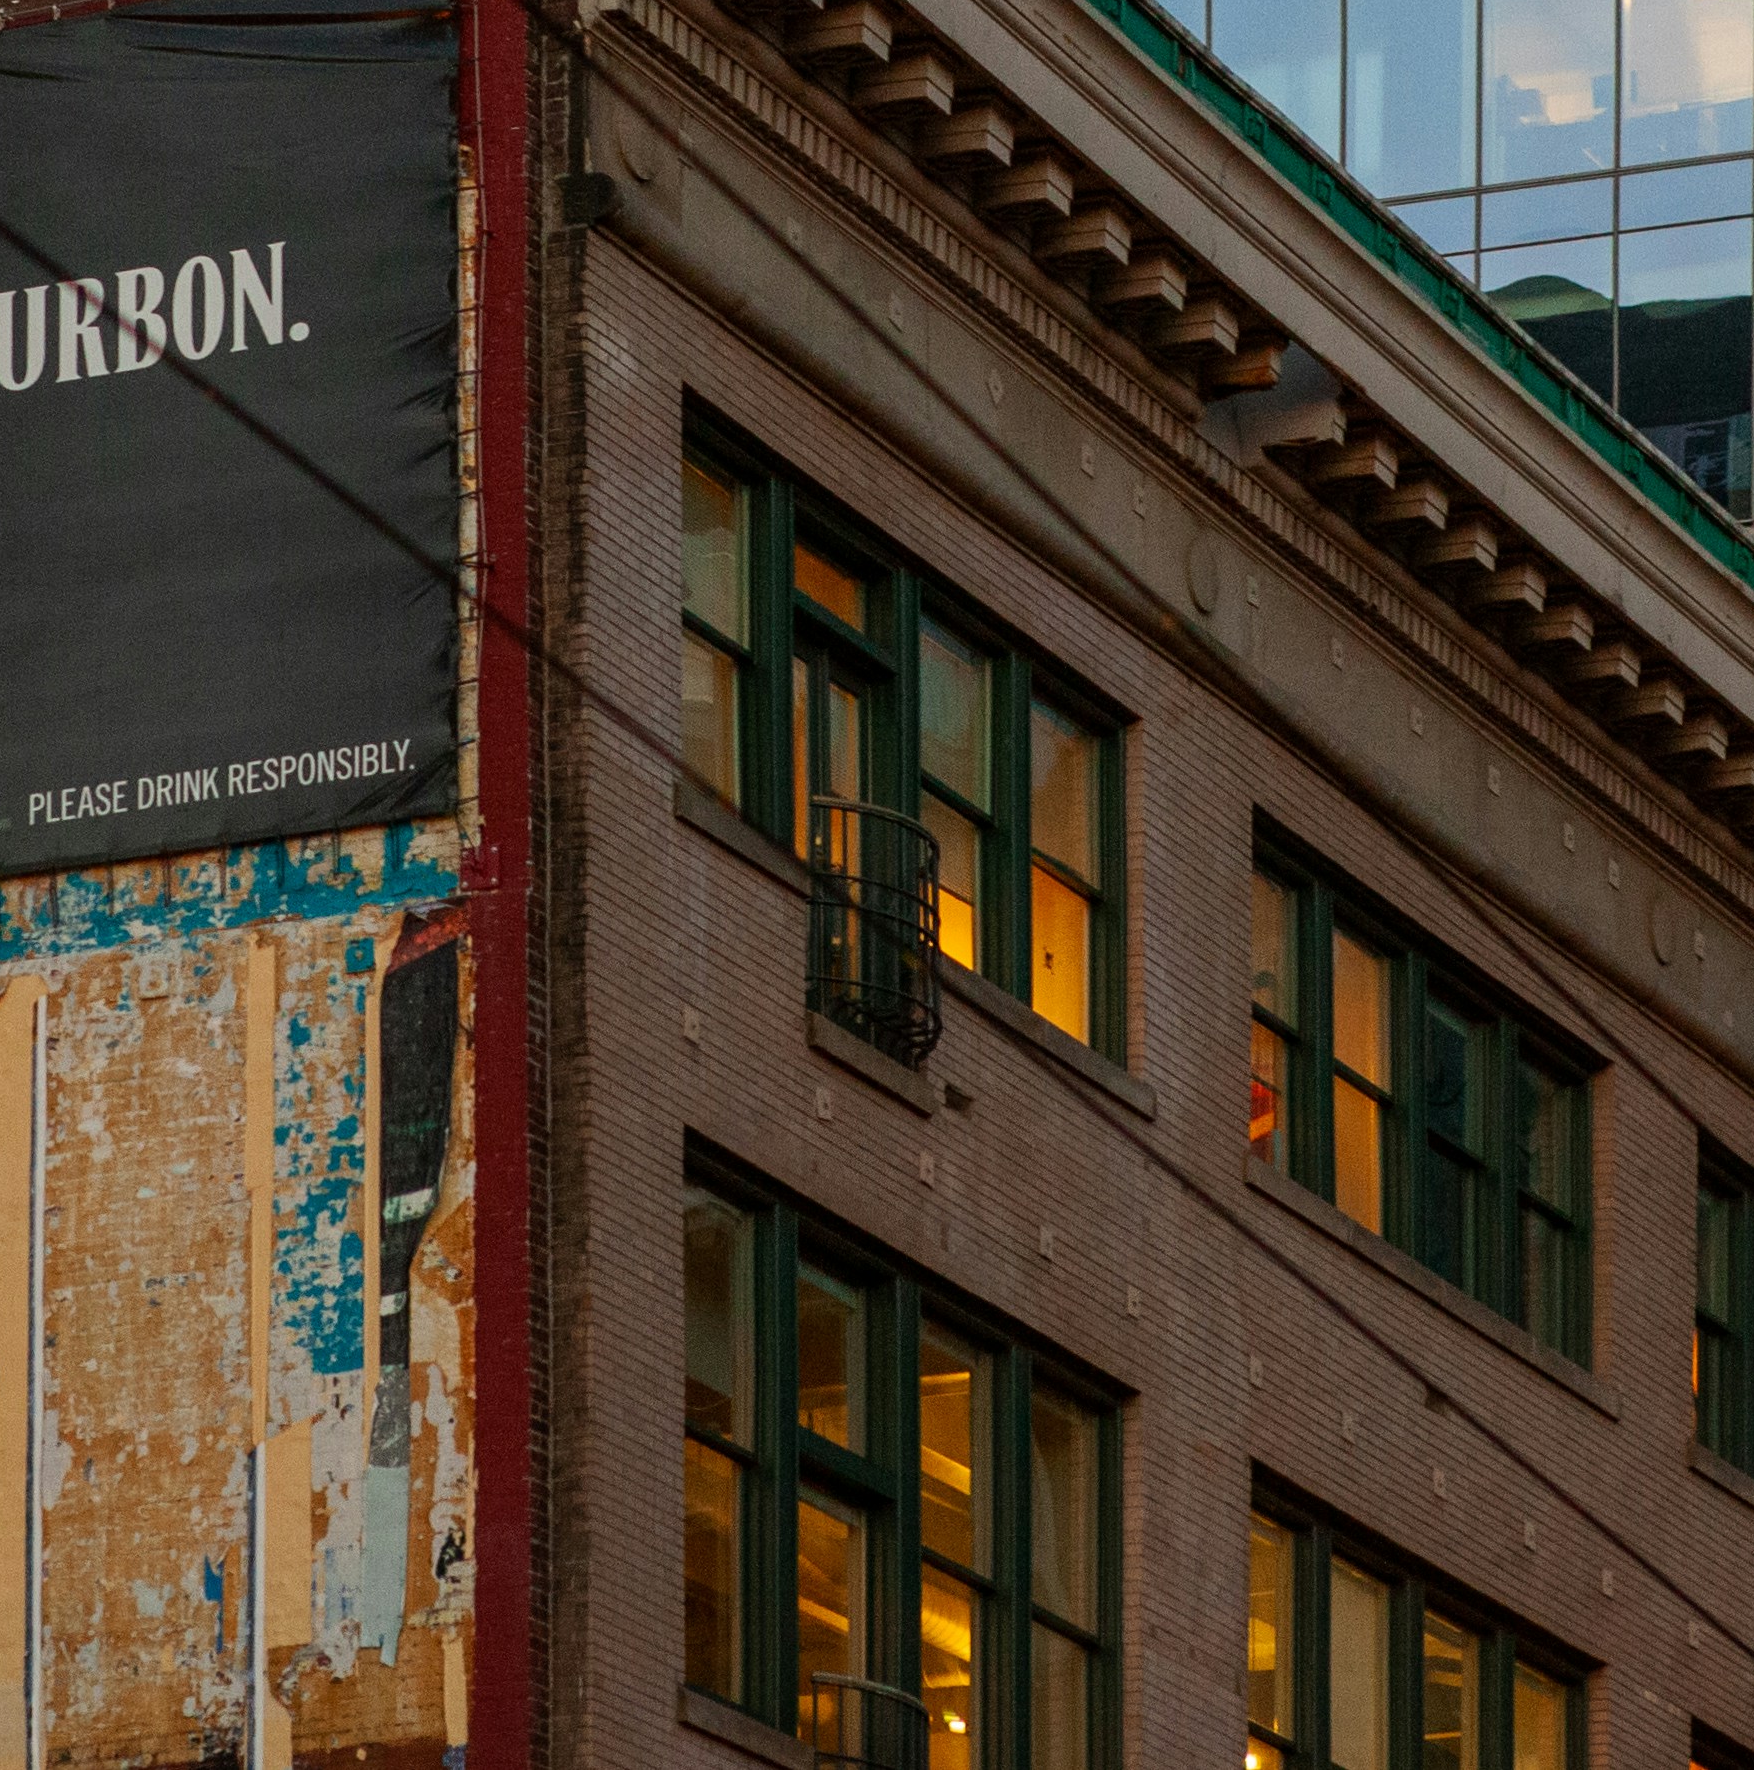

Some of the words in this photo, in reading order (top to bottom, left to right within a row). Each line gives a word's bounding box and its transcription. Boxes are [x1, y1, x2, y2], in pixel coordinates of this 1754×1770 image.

[28, 780, 129, 827] PLEASE
[136, 767, 221, 810] DRINK
[227, 738, 415, 797] RESPONSIBLY.
